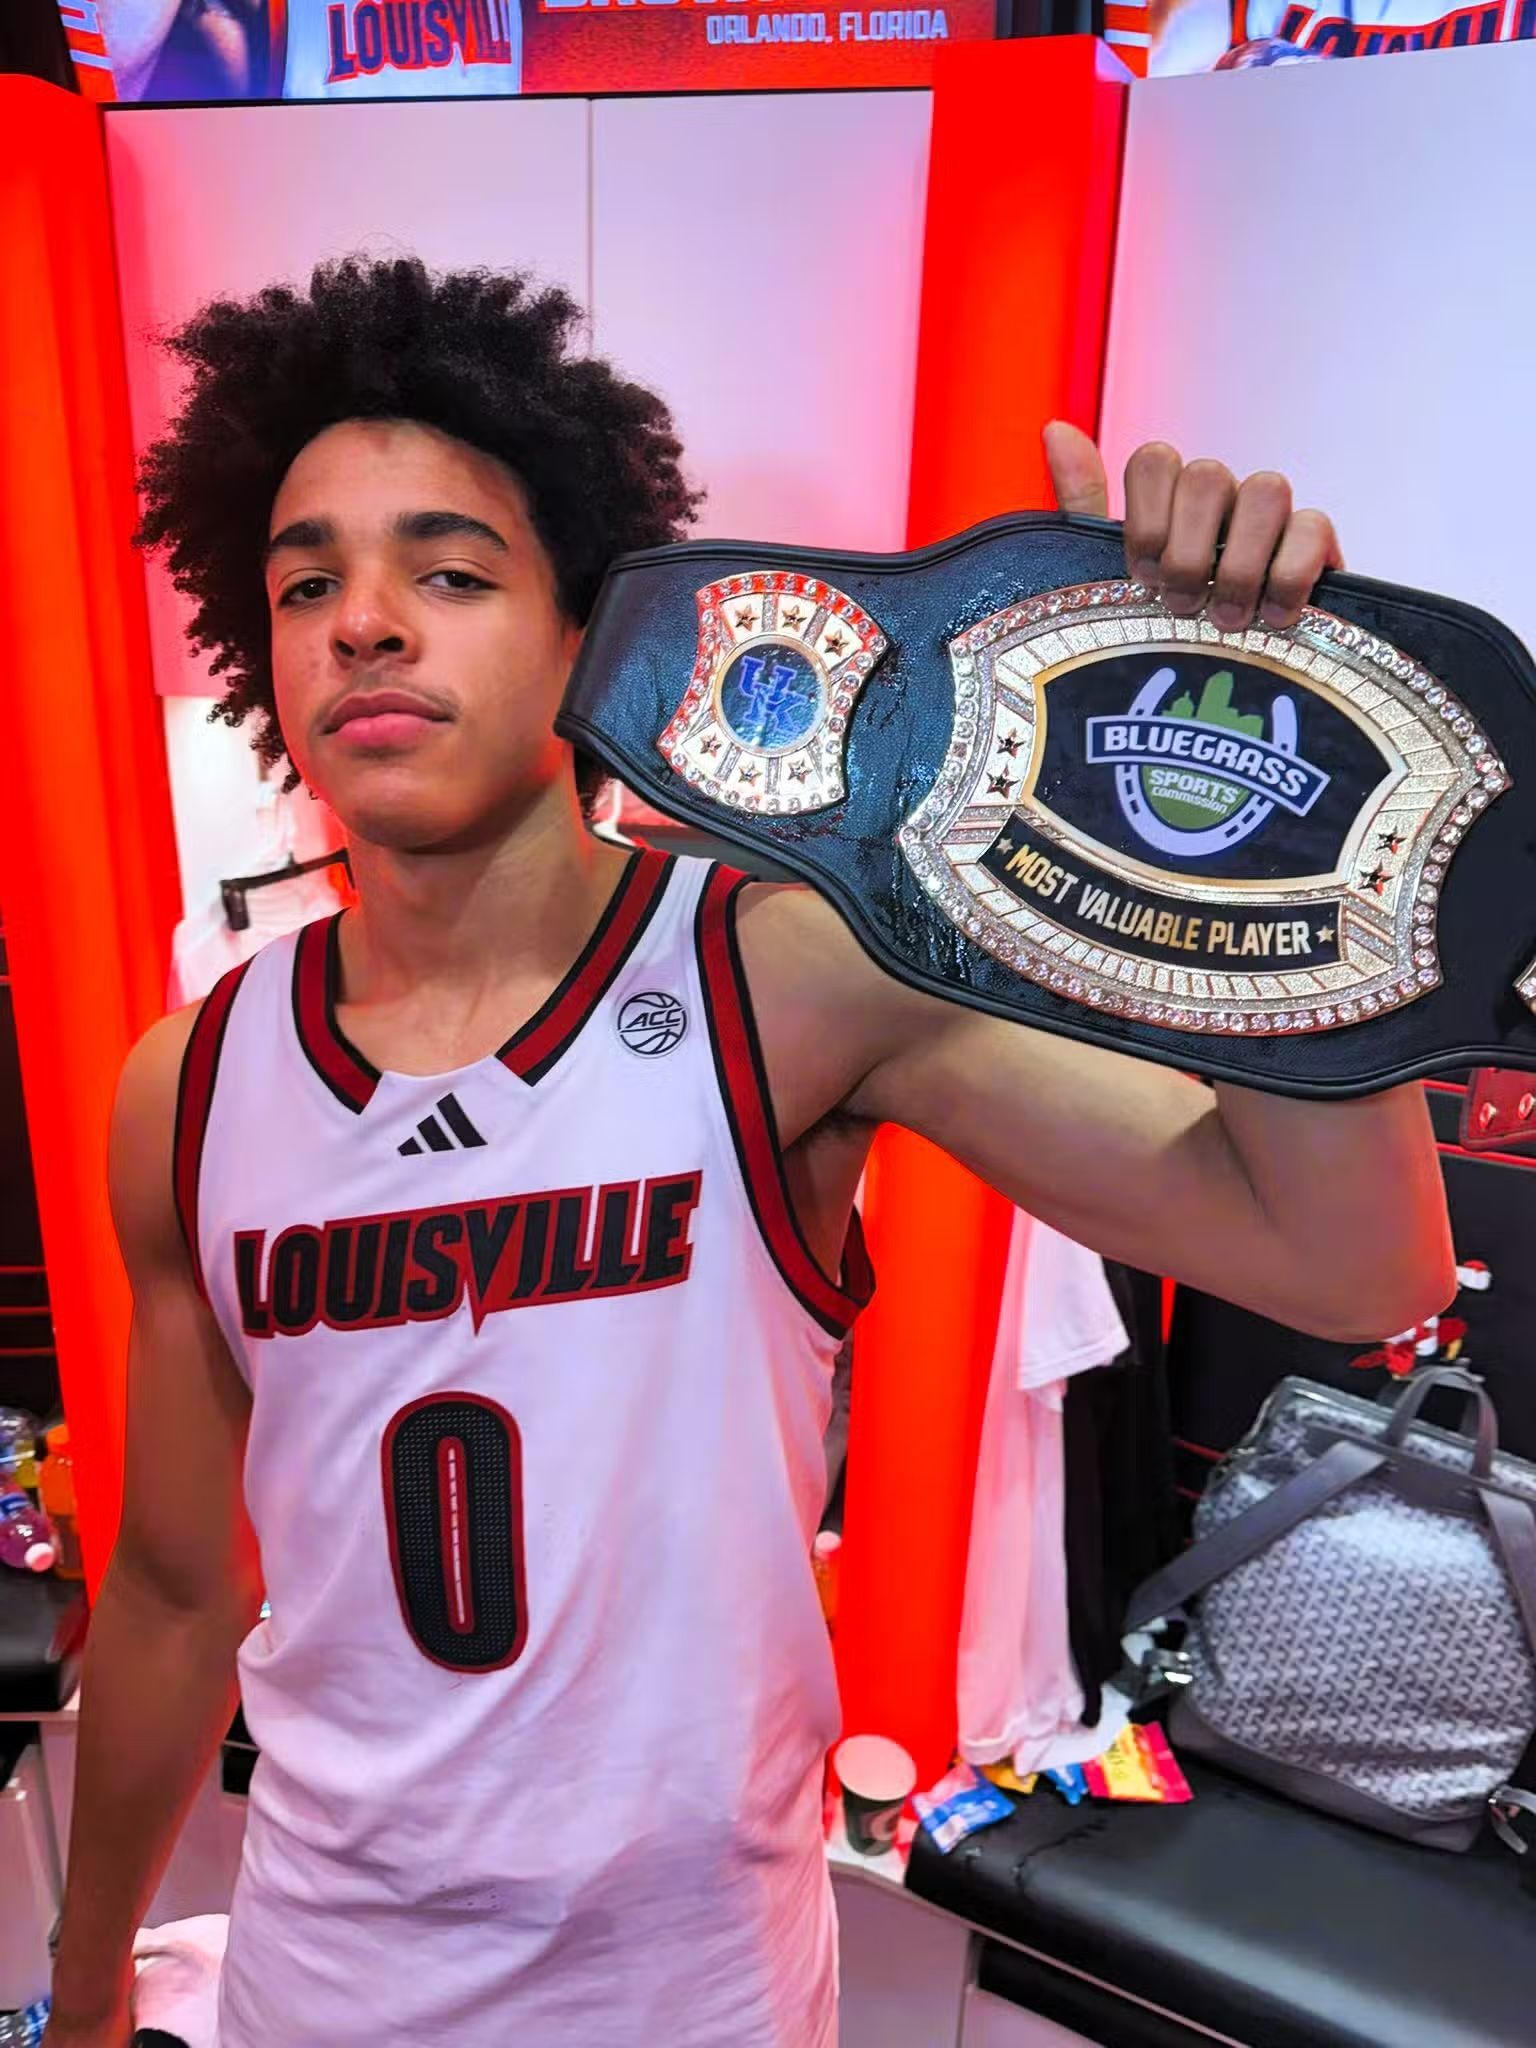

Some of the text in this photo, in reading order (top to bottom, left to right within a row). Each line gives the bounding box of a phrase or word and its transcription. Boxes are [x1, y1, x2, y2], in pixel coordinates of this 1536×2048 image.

[706, 9, 949, 45] ORLANDO, FLORIDA
[1103, 724, 1309, 798] BLUEGRASS
[1149, 769, 1239, 804] SPORTS
[1003, 843, 1312, 956] MOST VALUABLE PLAYER
[624, 1007, 684, 1029] ACC
[233, 1169, 704, 1338] LOUISVILLE
[380, 1390, 529, 1674] 0
